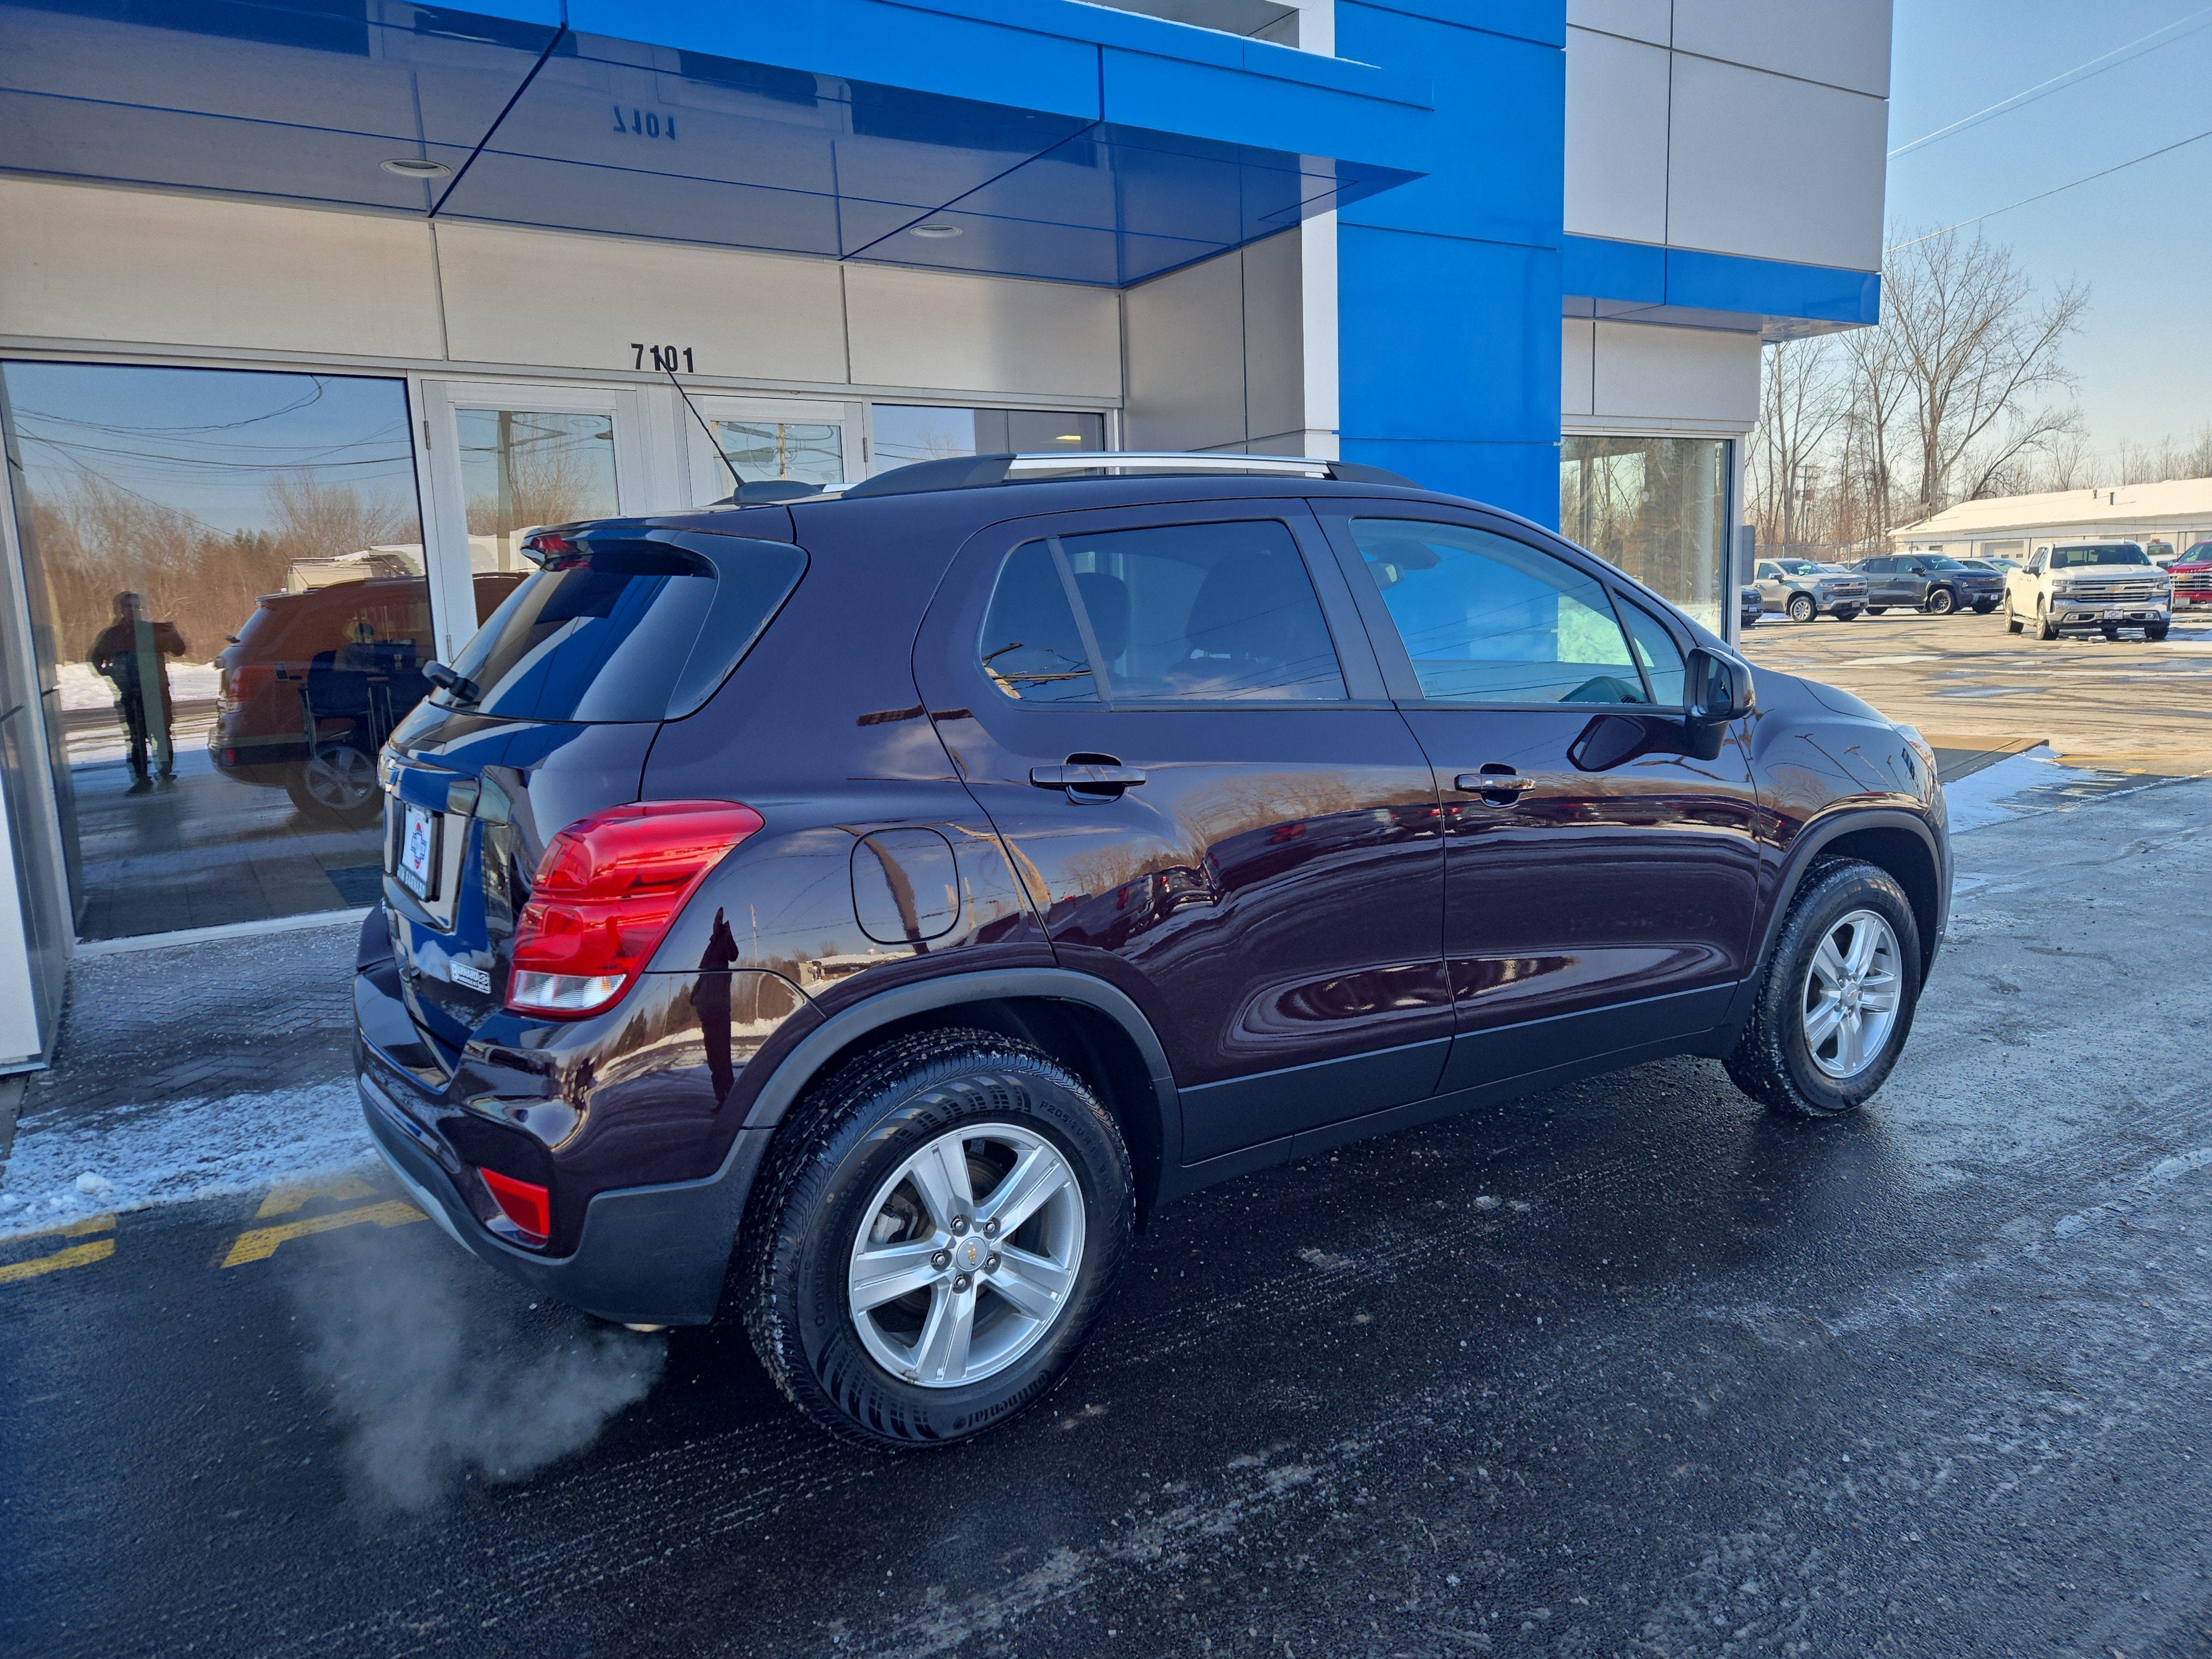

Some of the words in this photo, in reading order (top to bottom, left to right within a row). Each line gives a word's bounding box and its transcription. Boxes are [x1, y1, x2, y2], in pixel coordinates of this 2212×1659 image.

[631, 343, 694, 374] 7101
[1039, 1101, 1084, 1136] P205/70
[968, 1368, 1051, 1427] Continental
